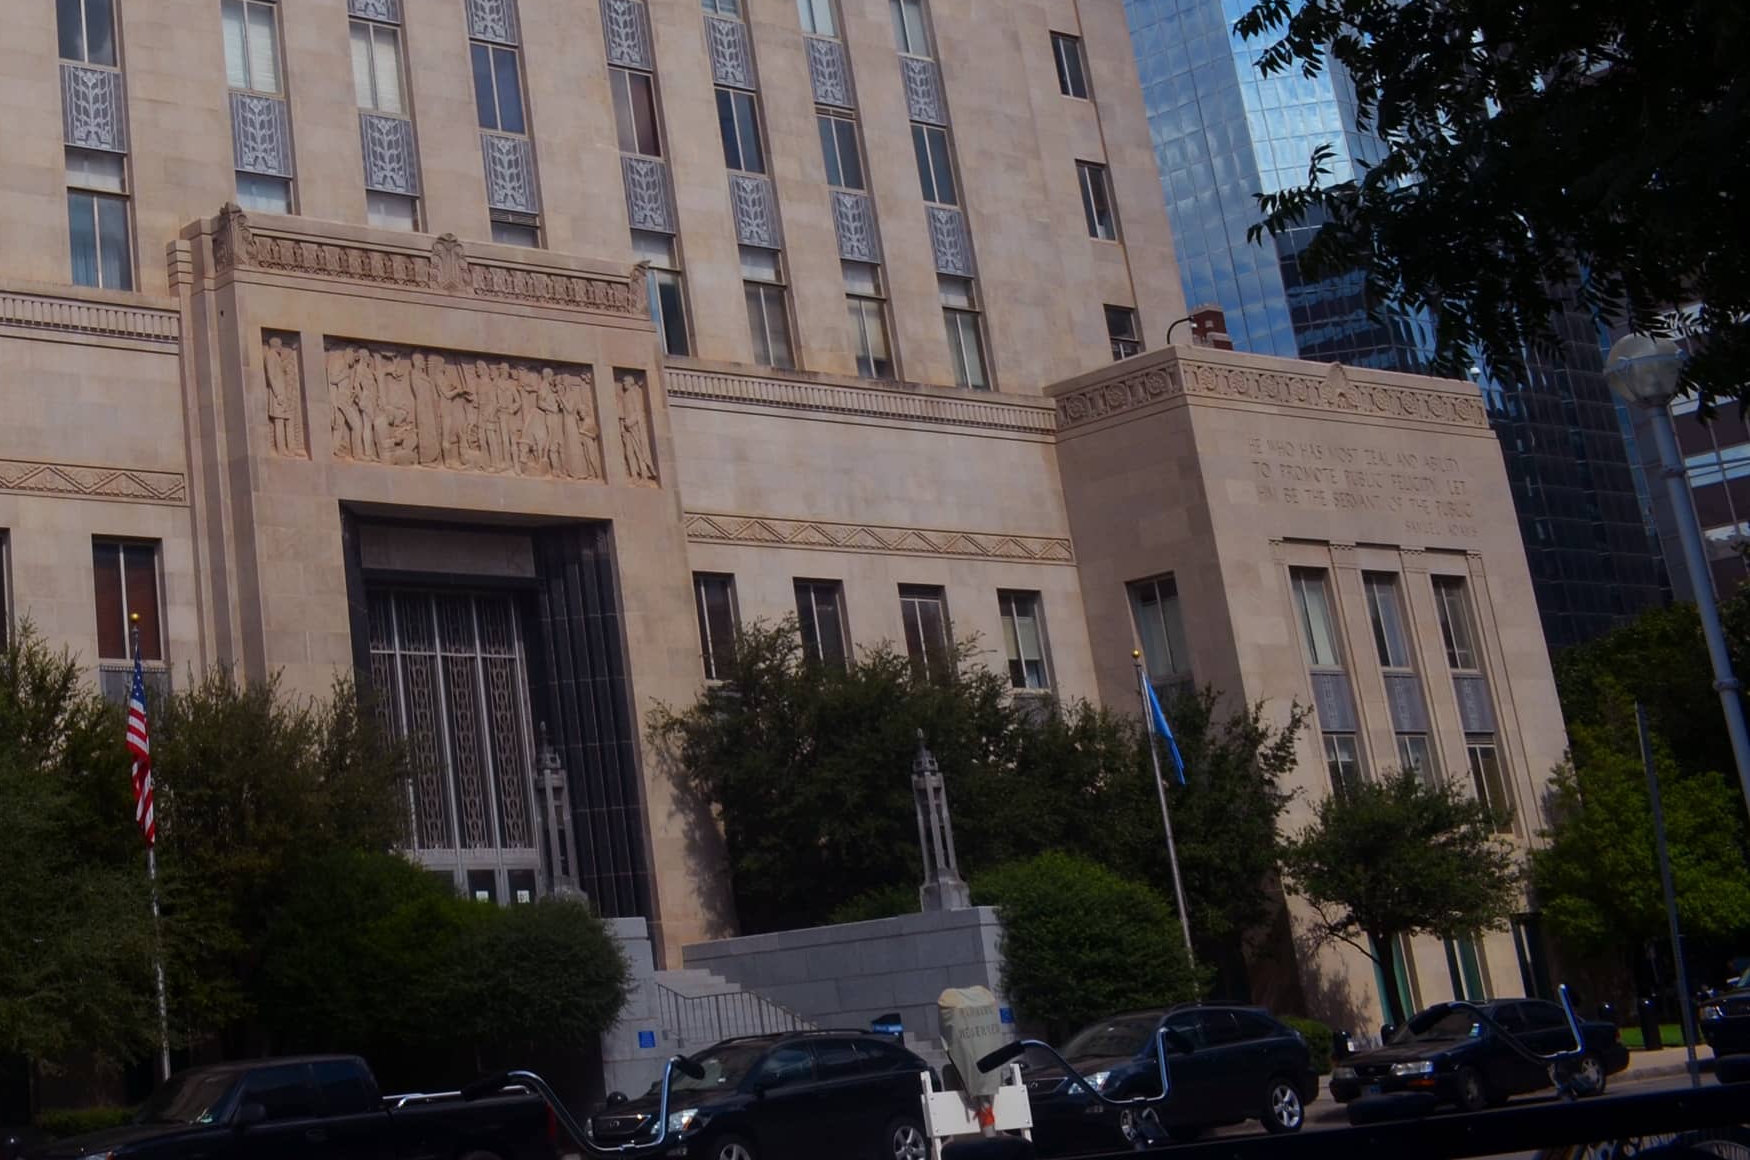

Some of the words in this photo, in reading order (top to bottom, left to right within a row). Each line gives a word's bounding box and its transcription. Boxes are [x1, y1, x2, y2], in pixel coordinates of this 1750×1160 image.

[1266, 439, 1294, 457] WHO
[1299, 442, 1323, 460] HAS
[1395, 451, 1418, 469] AND
[1250, 460, 1272, 480] TO
[1279, 463, 1339, 485] PROMOTE
[1344, 469, 1383, 489] PUBLIC
[1445, 478, 1466, 496] LET
[1283, 487, 1299, 504] BE
[1303, 489, 1328, 507] THE
[1408, 497, 1431, 516] THE
